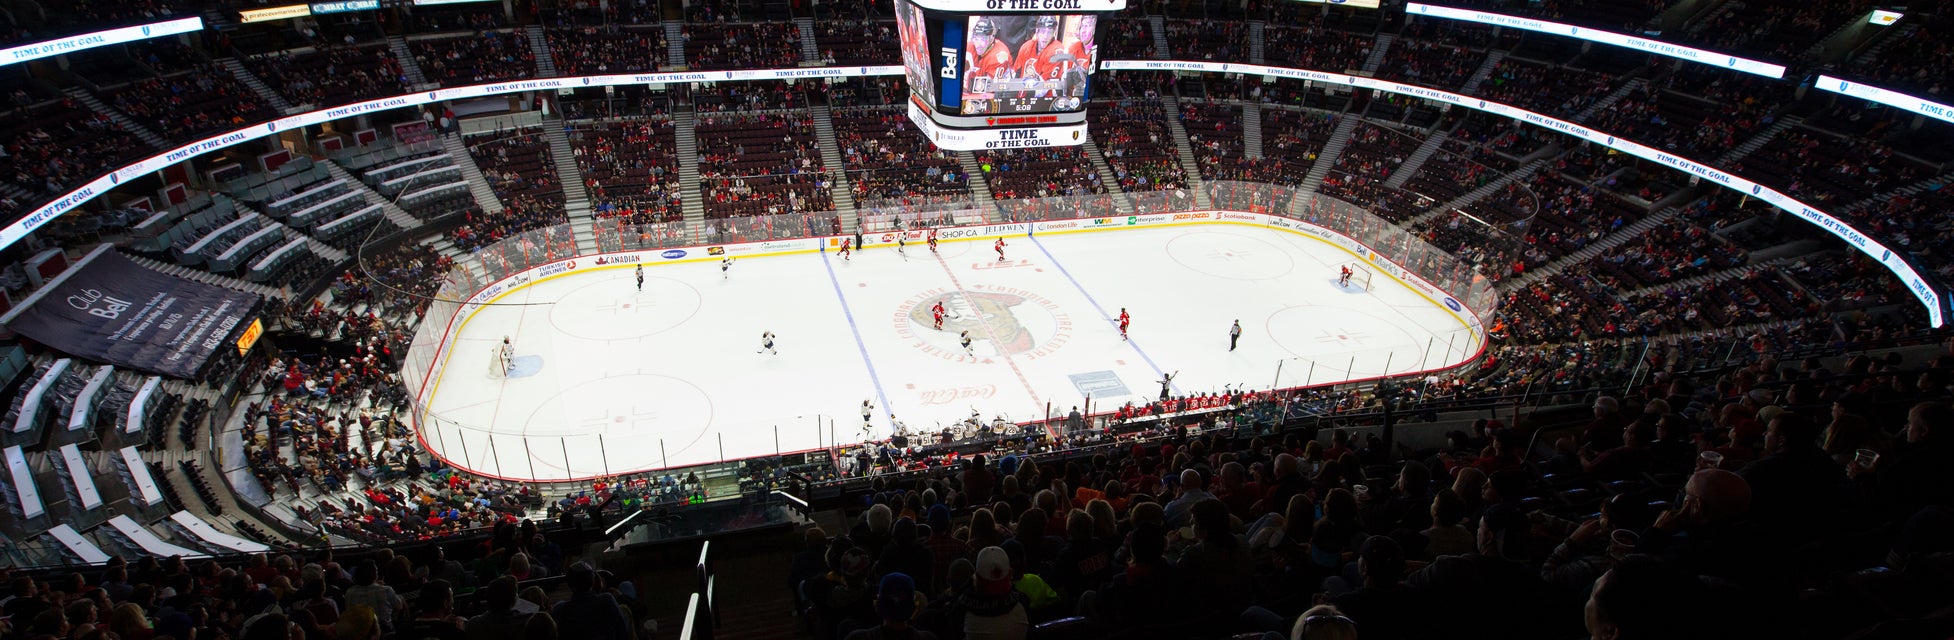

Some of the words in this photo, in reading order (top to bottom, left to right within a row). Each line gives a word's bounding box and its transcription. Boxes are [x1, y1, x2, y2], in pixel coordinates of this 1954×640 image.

[986, 0, 1006, 9] OF
[1008, 0, 1038, 9] THE
[1042, 0, 1081, 9] GOAL
[1476, 14, 1495, 22] TIME
[1522, 20, 1544, 29] GOAL
[13, 47, 40, 59] TIME
[78, 35, 106, 46] GOAL
[1626, 38, 1646, 48] TIME
[1676, 48, 1698, 58] GOAL
[940, 47, 958, 79] Bell
[1088, 44, 1098, 76] Bell
[1051, 66, 1060, 78] 6
[1396, 85, 1414, 93] TIME
[1442, 94, 1460, 102] GOAL
[327, 106, 350, 118] TIME
[383, 98, 408, 107] GOAL
[1920, 103, 1944, 116] TIME
[1000, 129, 1038, 140] TIME
[1526, 113, 1543, 123] TIME
[1570, 126, 1590, 137] GOAL
[166, 149, 189, 162] TIME
[222, 132, 247, 144] GOAL
[986, 140, 1000, 148] OF
[1000, 139, 1022, 147] THE
[1024, 138, 1050, 146] GOAL
[1656, 154, 1678, 165] TIME
[1708, 171, 1730, 184] GOAL
[22, 213, 42, 230] TIME
[72, 188, 94, 203] GOAL
[1173, 213, 1191, 221] pizza
[1192, 212, 1209, 220] pizza
[1802, 208, 1822, 223] TIME
[1849, 232, 1866, 247] GOAL
[606, 254, 640, 264] CANADIAN
[1357, 245, 1367, 256] Bell
[538, 262, 566, 272] TURKISH
[539, 267, 567, 278] AIRLINES
[1374, 256, 1398, 275] Mark's
[1408, 276, 1434, 295] Scotiabank
[1912, 278, 1926, 296] TIME
[67, 289, 102, 310] Club
[88, 296, 132, 319] Bell
